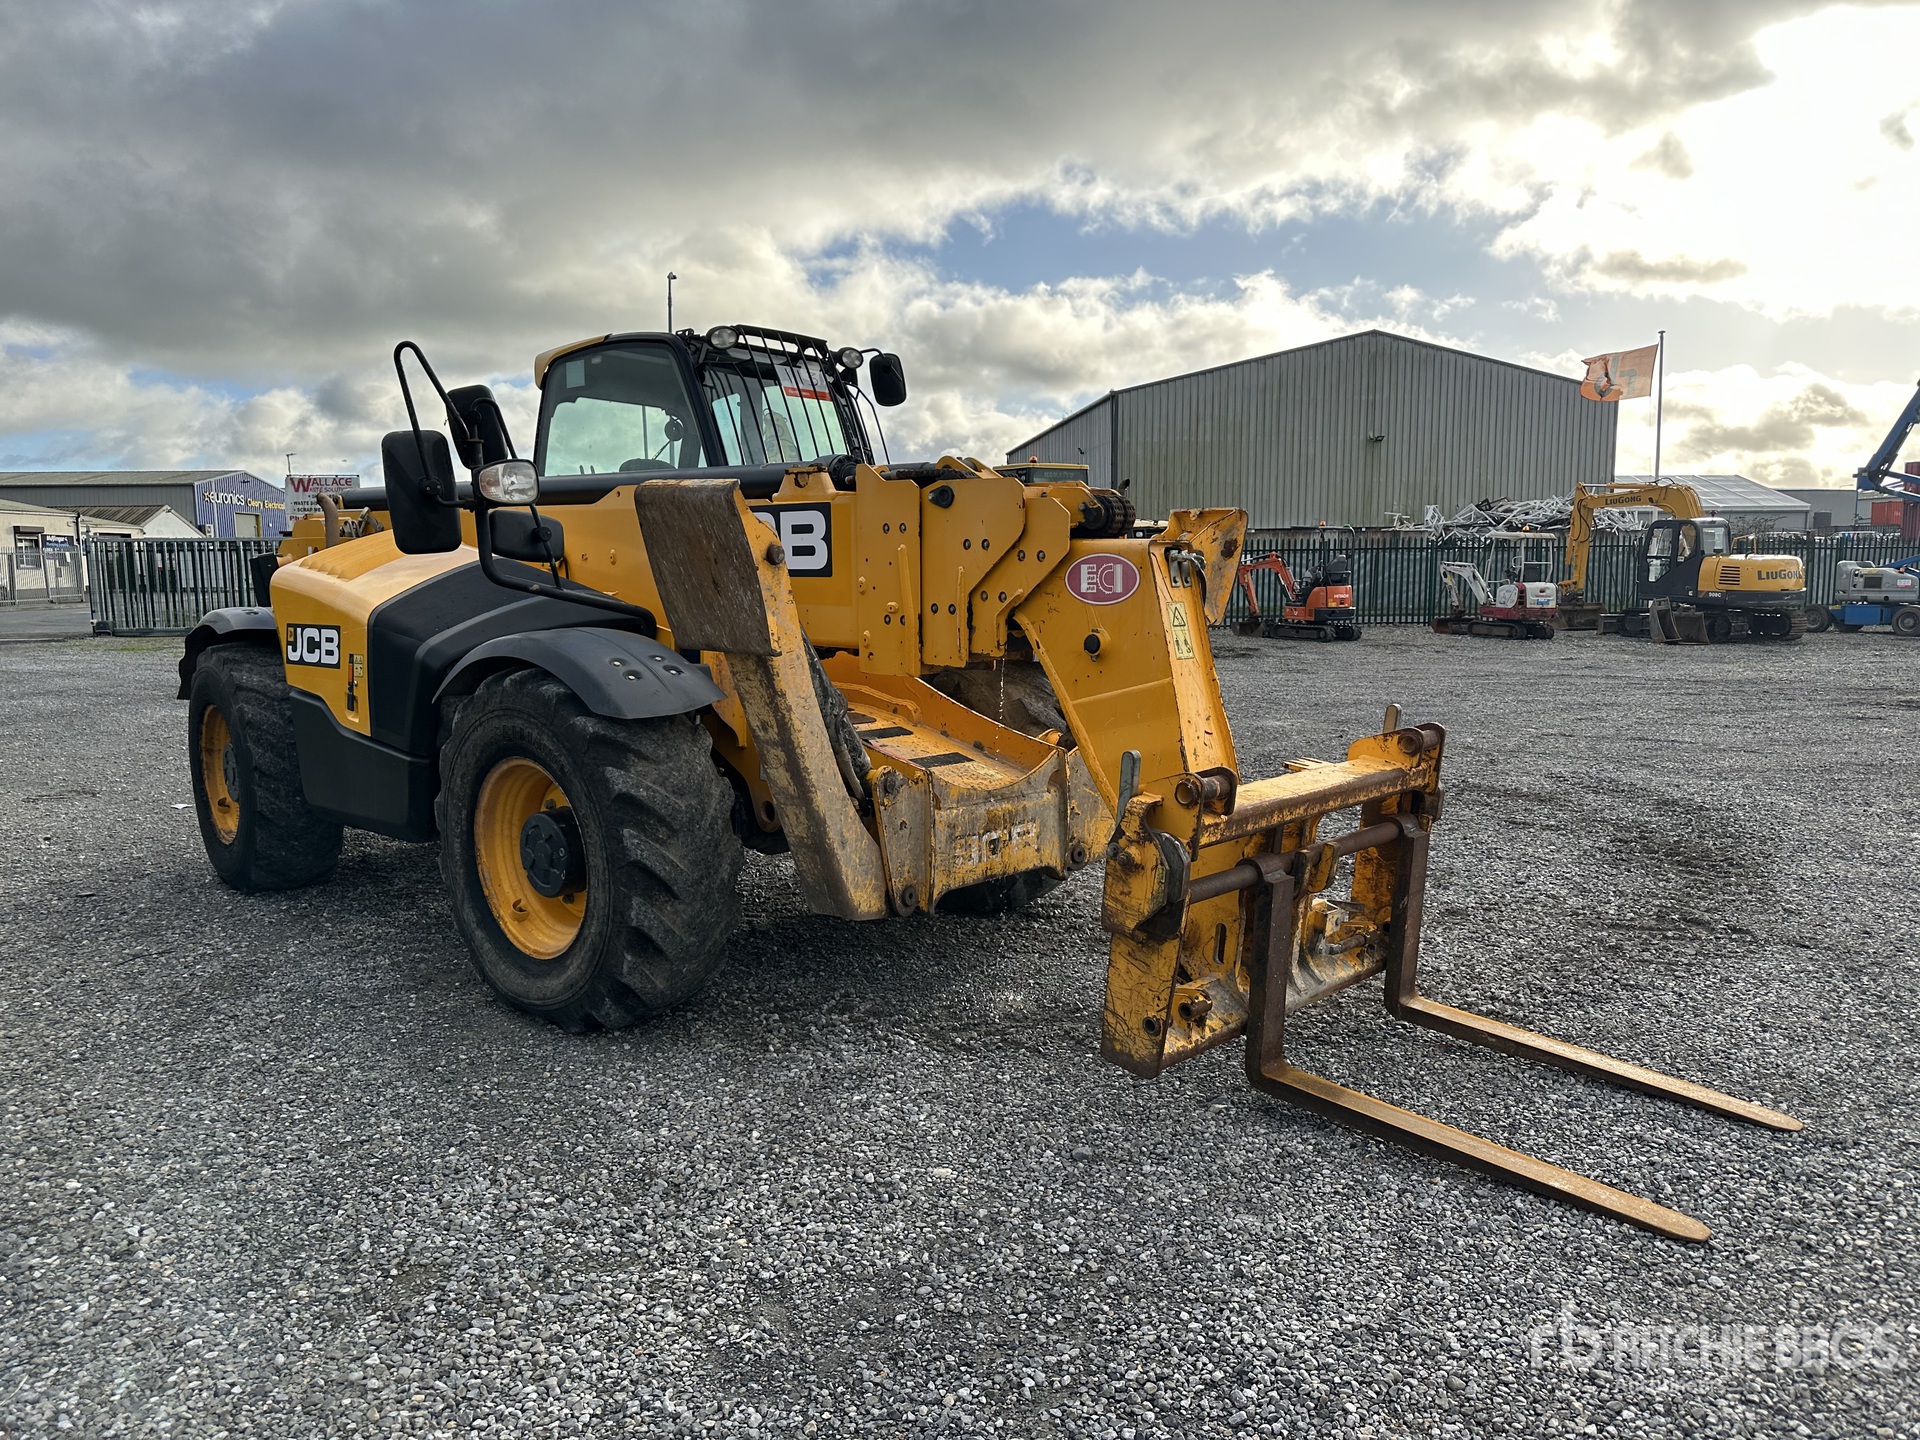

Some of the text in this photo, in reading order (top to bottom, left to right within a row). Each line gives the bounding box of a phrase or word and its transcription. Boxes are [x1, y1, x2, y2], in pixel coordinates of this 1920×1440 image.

[290, 477, 353, 493] WALLACE
[210, 490, 245, 506] euronics
[1080, 563, 1123, 594] ECI
[287, 627, 340, 665] JCB
